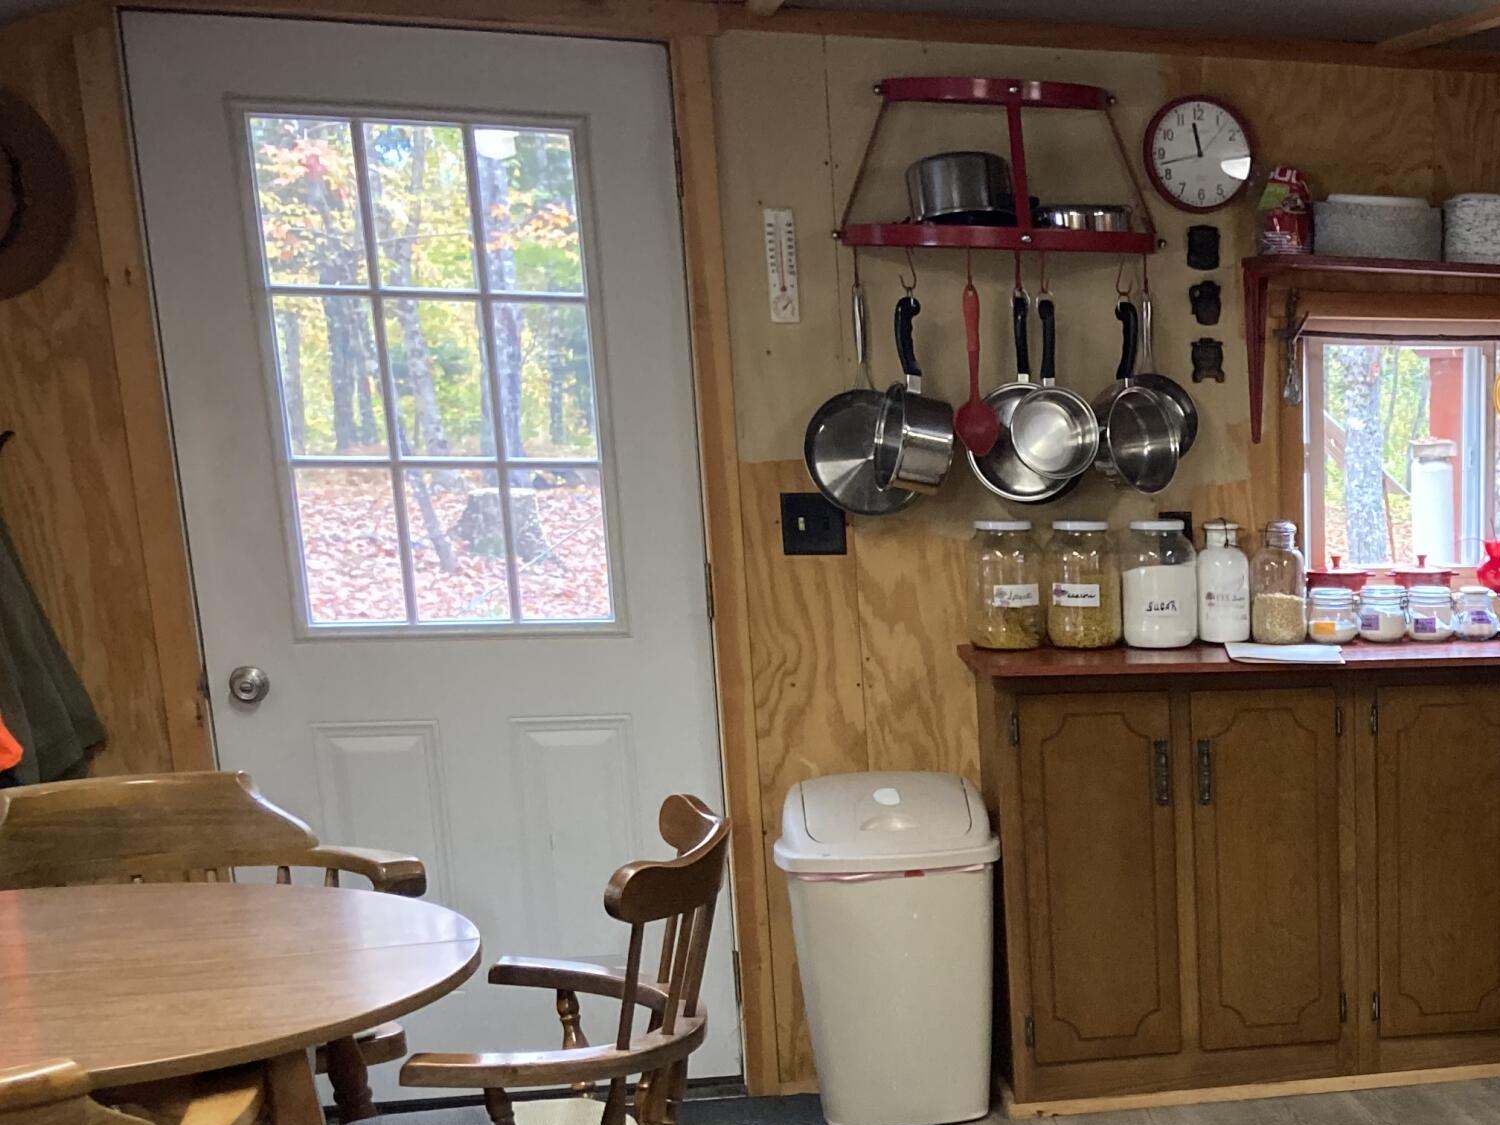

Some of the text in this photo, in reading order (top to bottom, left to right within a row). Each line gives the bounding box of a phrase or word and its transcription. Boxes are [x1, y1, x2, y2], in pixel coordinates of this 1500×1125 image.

[1176, 113, 1185, 127] 11
[1192, 107, 1205, 121] 12
[1162, 129, 1174, 142] 10
[1228, 129, 1237, 142] 2
[1157, 147, 1166, 159] 9
[1164, 168, 1173, 180] 8
[1178, 182, 1187, 196] 7
[1197, 188, 1206, 201] 6
[1215, 183, 1225, 196] 5
